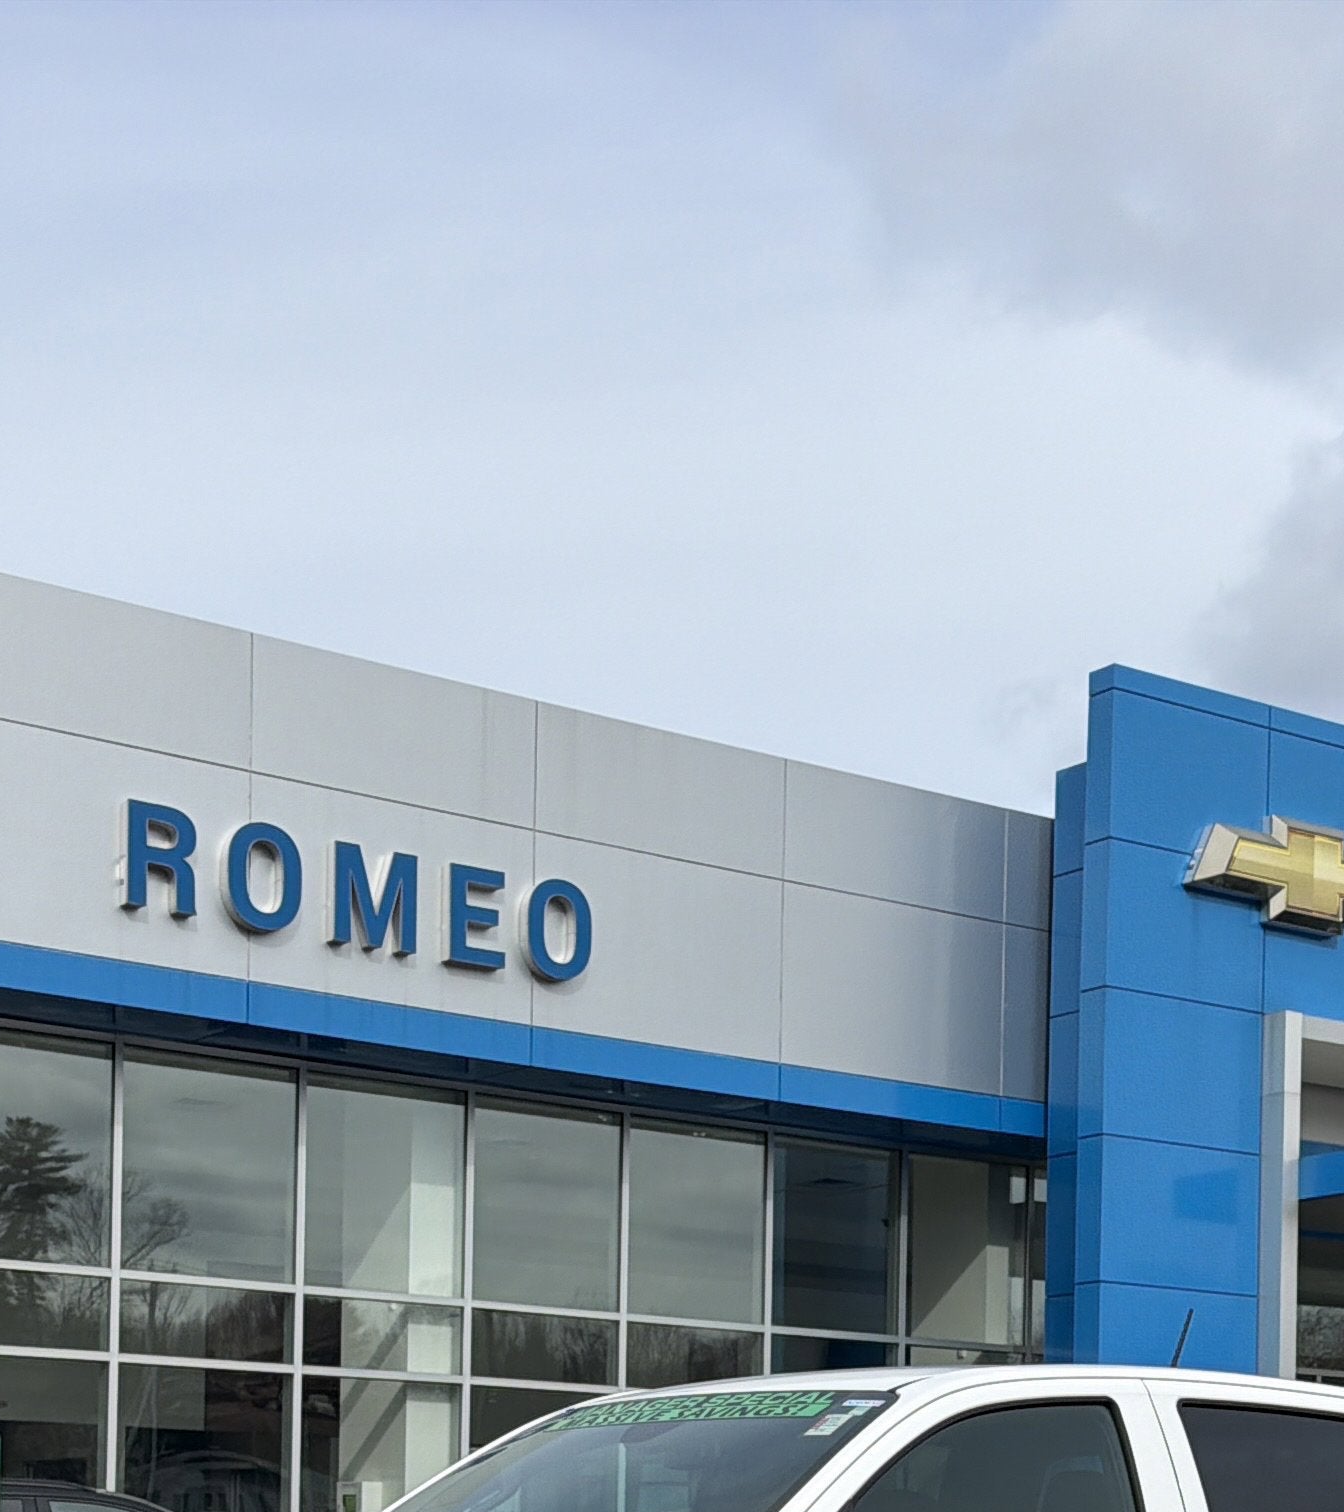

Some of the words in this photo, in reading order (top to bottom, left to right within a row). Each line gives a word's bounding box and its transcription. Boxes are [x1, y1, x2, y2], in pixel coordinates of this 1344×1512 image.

[123, 798, 592, 982] ROMEO
[703, 1391, 836, 1407] SPECIAL
[559, 1408, 672, 1429] MASSIVE
[672, 1403, 806, 1420] SAVINGS!
